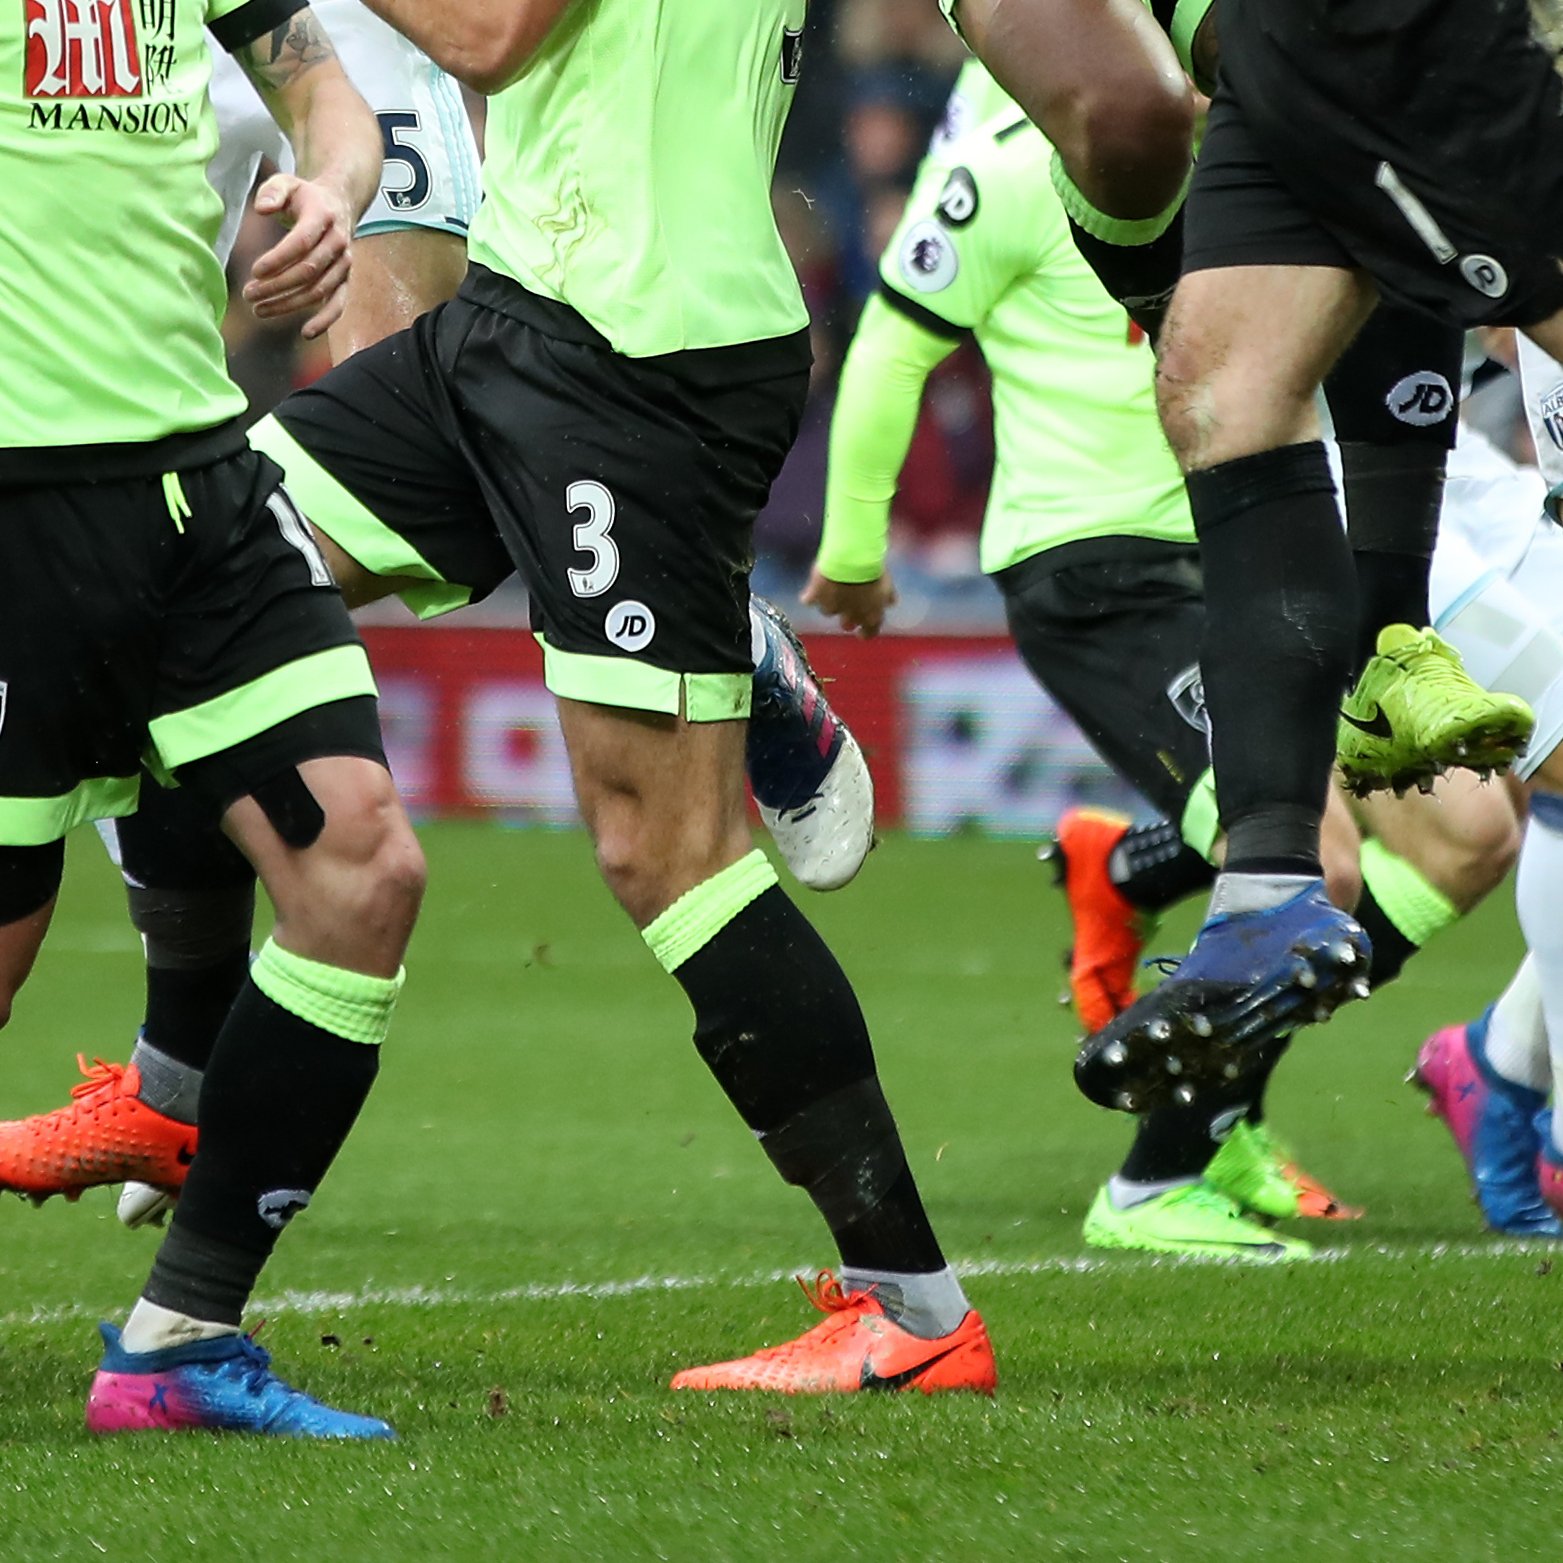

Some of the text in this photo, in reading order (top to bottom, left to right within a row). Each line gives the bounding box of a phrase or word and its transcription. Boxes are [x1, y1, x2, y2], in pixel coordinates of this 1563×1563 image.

[27, 102, 190, 134] MANSION
[1399, 383, 1449, 414] JD
[565, 479, 620, 598] 3
[615, 615, 647, 638] JD
